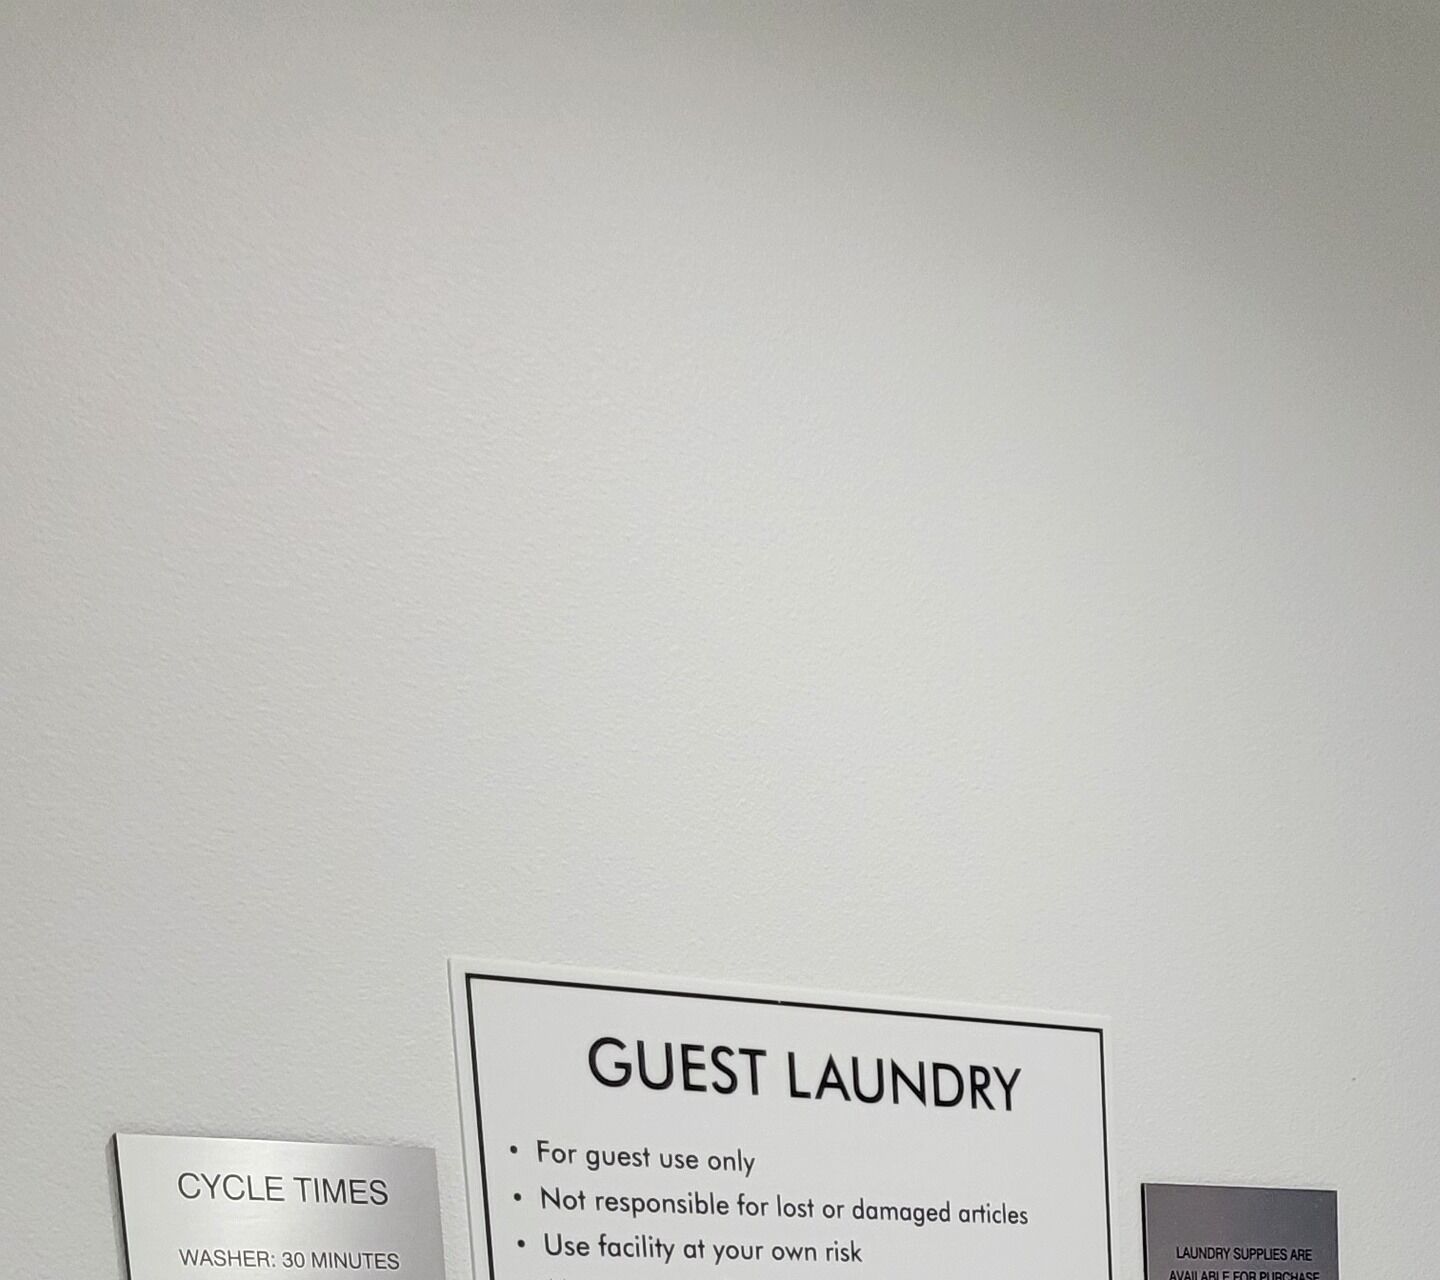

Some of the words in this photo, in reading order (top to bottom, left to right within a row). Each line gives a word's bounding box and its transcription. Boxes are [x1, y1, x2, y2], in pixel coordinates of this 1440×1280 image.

[588, 1036, 767, 1095] GUEST
[787, 1051, 1021, 1111] LAUNDRY
[536, 1139, 577, 1164] For
[585, 1147, 650, 1171] guest
[659, 1153, 699, 1169] use
[707, 1148, 755, 1178] only
[177, 1172, 284, 1201] CYCLE
[293, 1177, 388, 1205] TIMES
[540, 1186, 586, 1210] Not
[595, 1191, 729, 1218] responsible
[736, 1192, 769, 1216] for
[776, 1194, 814, 1218] lost
[822, 1204, 844, 1219] or
[852, 1197, 950, 1227] damaged
[958, 1202, 1028, 1225] articles
[178, 1249, 275, 1267] WASHER:
[282, 1251, 305, 1268] 30
[311, 1251, 400, 1270] MINUTES
[544, 1233, 590, 1256] Use
[598, 1233, 675, 1264] facility
[683, 1239, 705, 1259] at
[713, 1244, 764, 1265] your
[771, 1246, 817, 1261] own
[826, 1239, 862, 1262] risk
[1176, 1246, 1230, 1260] LAUNDRY
[1233, 1247, 1287, 1261] SUPPLIES
[1289, 1248, 1312, 1261] ARE
